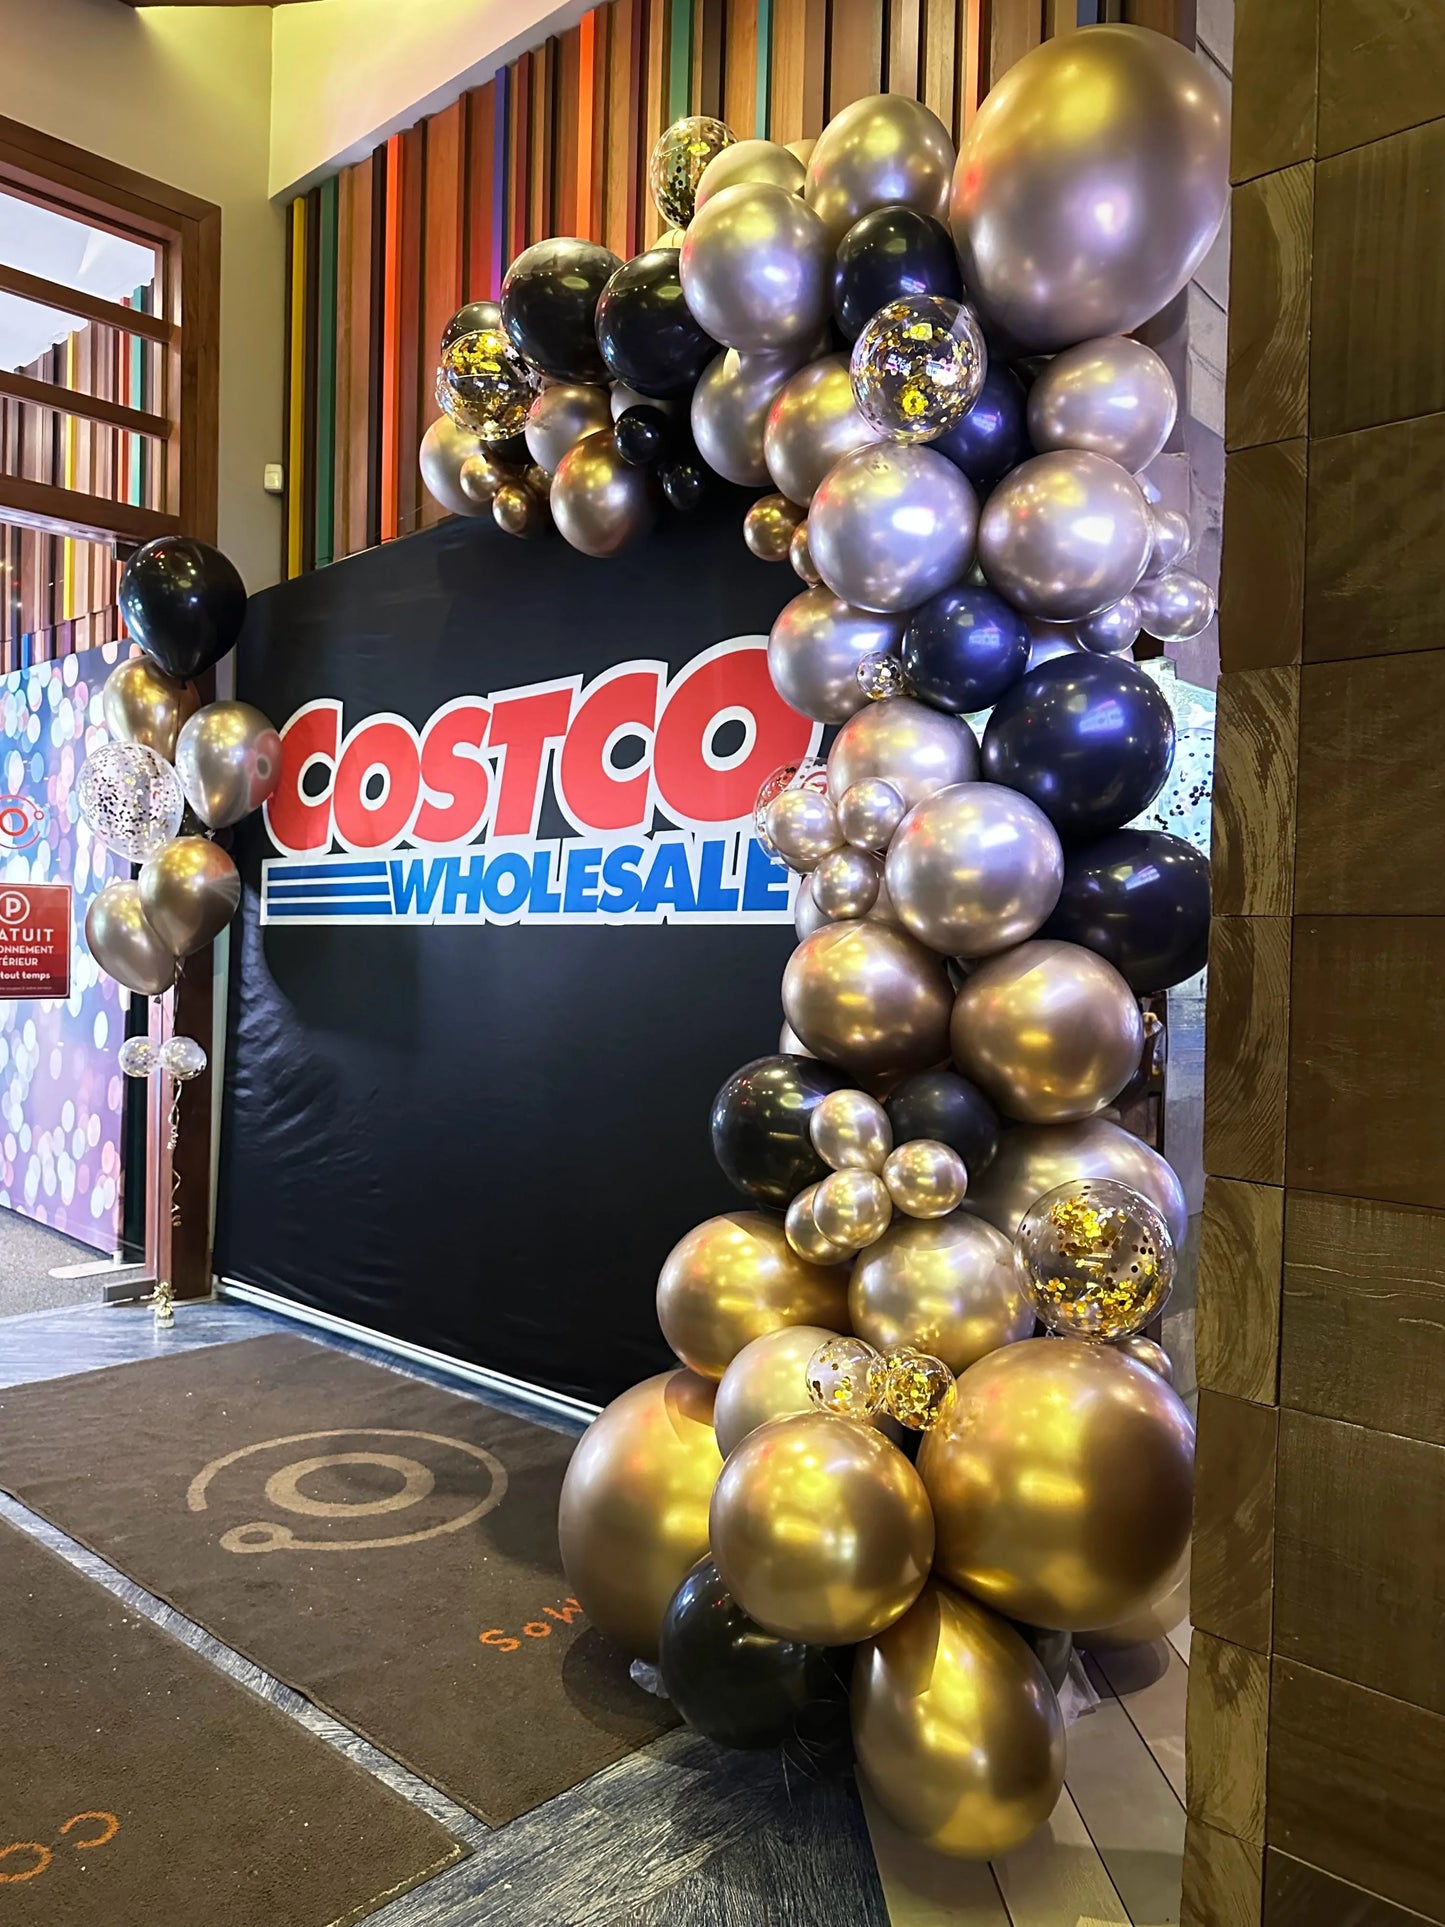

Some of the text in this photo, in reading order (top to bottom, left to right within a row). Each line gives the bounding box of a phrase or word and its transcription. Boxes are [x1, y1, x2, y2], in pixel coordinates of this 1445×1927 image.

[266, 648, 815, 851] COSTCO
[388, 838, 790, 915] WHOLESALE
[0, 928, 54, 942] ATUIT
[0, 971, 51, 981] tout temps
